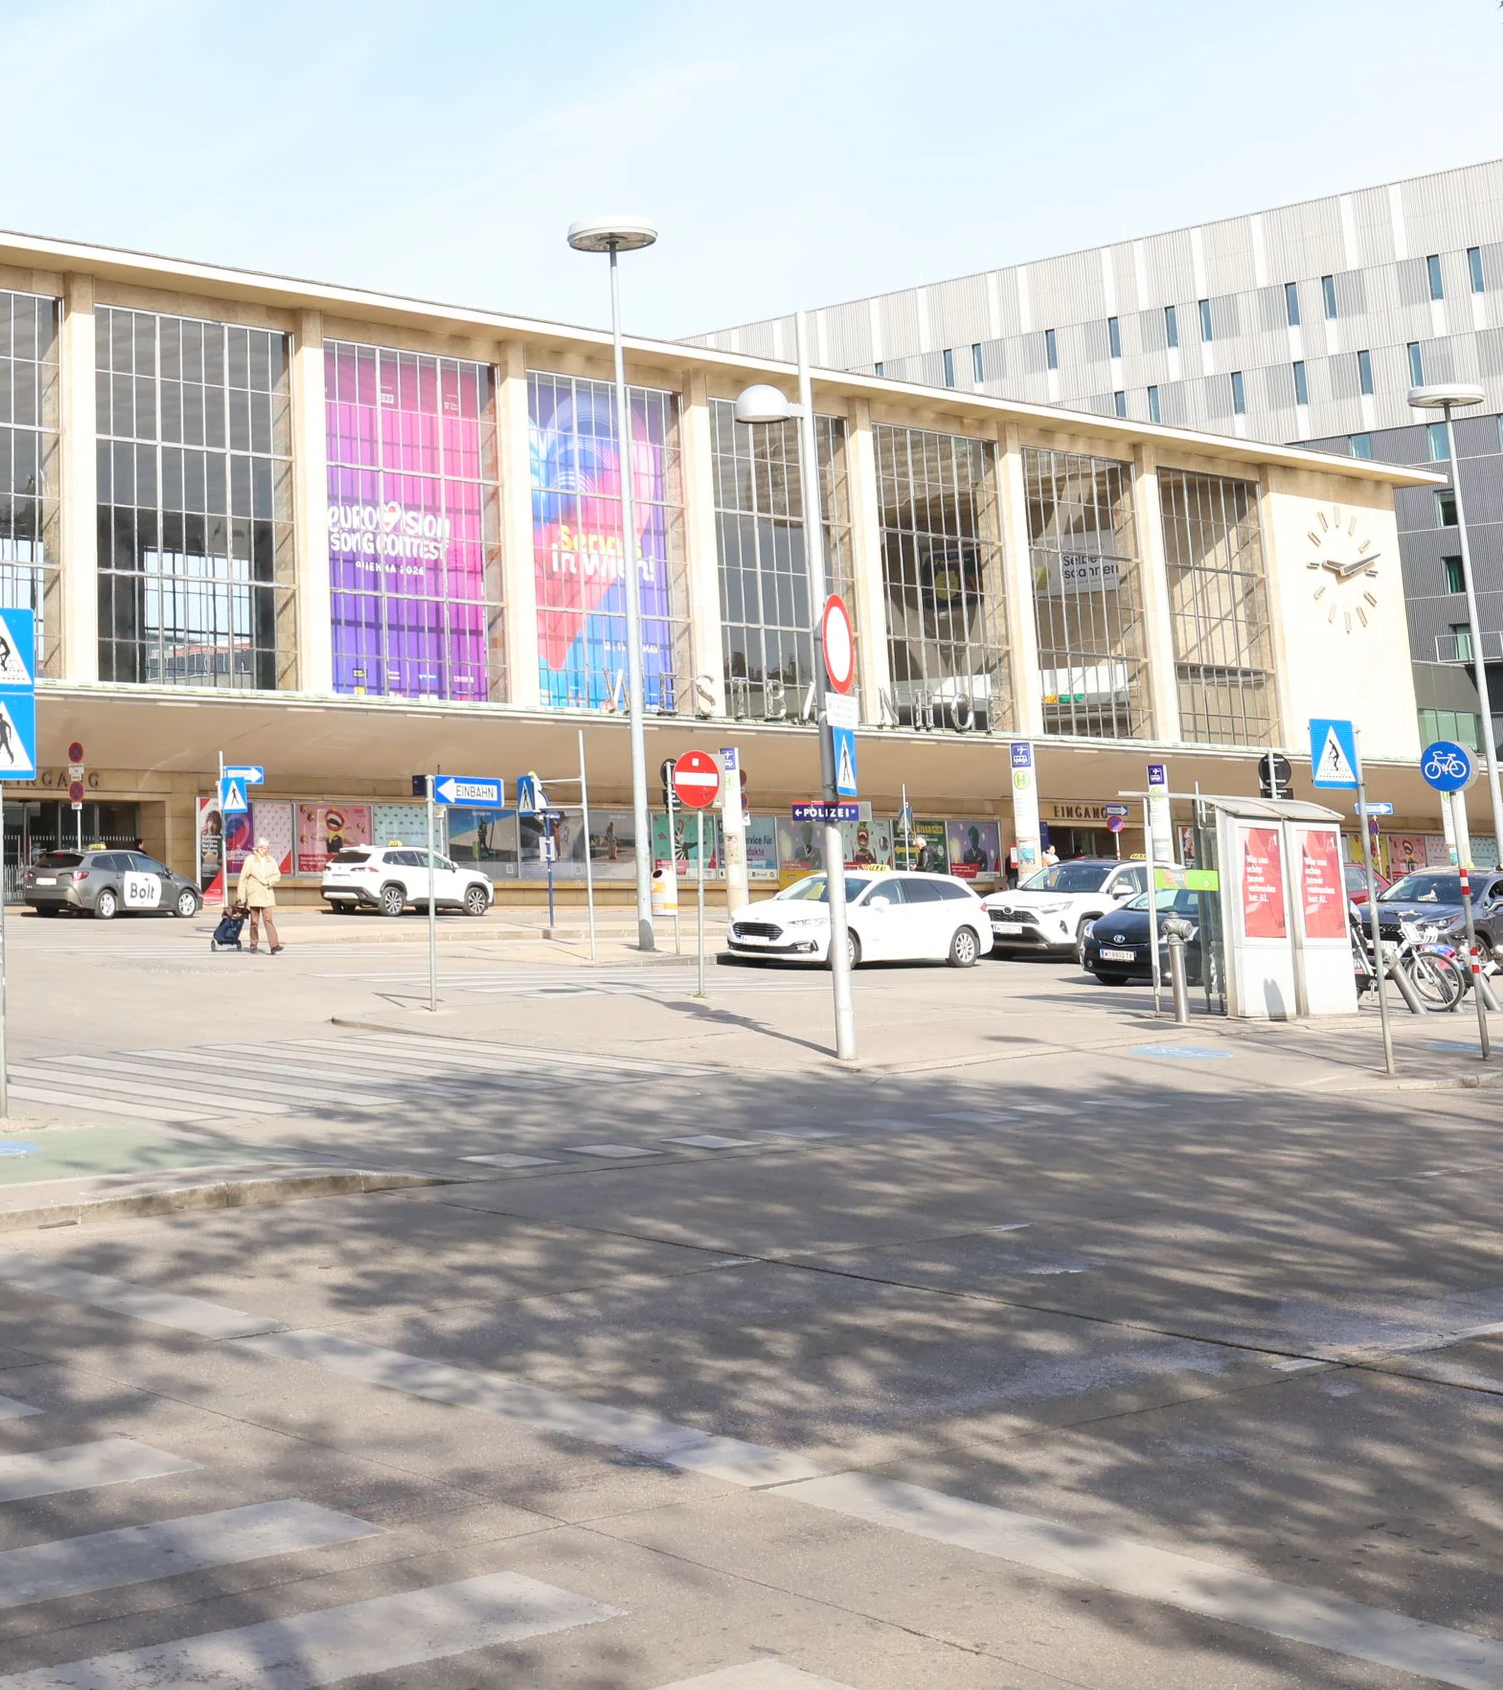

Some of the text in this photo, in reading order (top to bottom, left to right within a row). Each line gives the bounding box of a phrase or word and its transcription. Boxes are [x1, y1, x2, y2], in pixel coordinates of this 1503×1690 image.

[330, 531, 450, 560] SONG CONTEST
[551, 543, 577, 575] in
[603, 667, 1003, 732] WESTBANHOF
[456, 784, 494, 799] EINBAHN
[803, 807, 850, 818] POLIZEI
[1053, 805, 1108, 819] EINGANG
[745, 835, 773, 845] rvice für
[130, 882, 155, 900] Bolt
